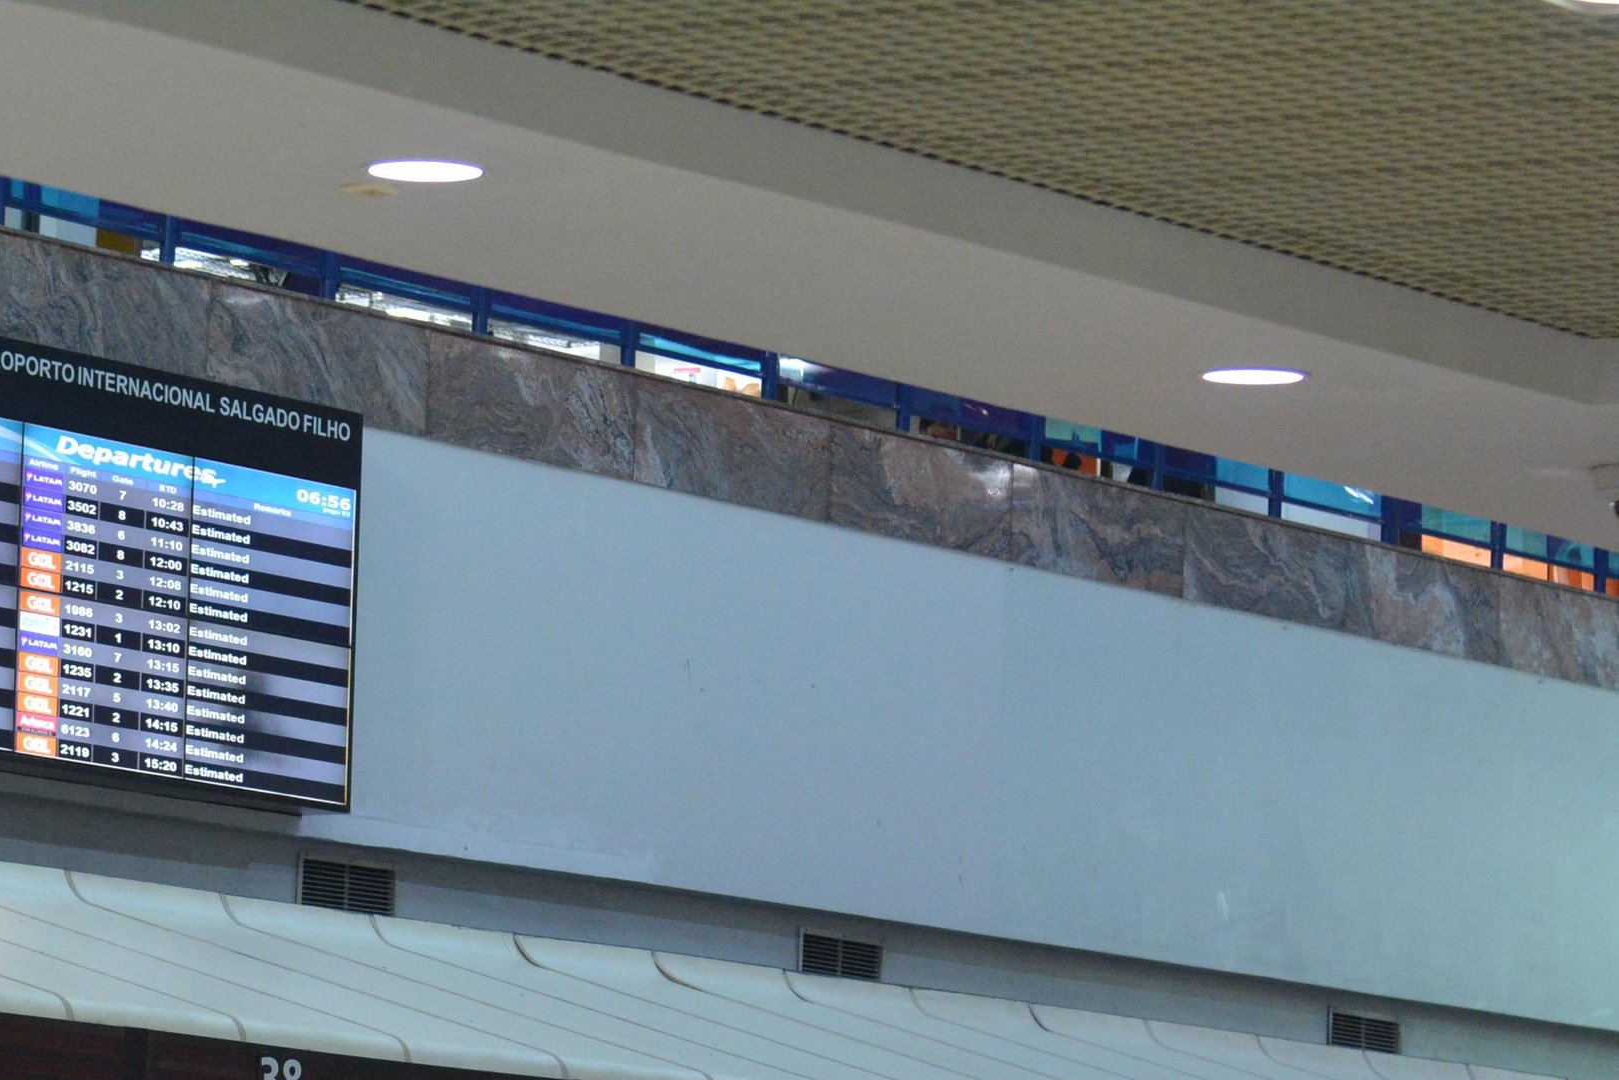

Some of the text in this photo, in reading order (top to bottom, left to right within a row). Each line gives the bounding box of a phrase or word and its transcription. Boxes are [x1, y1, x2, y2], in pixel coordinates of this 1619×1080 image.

[77, 365, 215, 413] INTERNACIONAL
[219, 396, 300, 430] SALGADO
[302, 413, 351, 441] FILHO
[53, 435, 218, 488] Departures
[68, 480, 97, 495] 3070
[296, 489, 351, 511] 06:56
[66, 519, 96, 534] 3836
[191, 523, 250, 545] Estimated
[65, 559, 94, 574] 2115
[64, 603, 93, 618] 1986
[188, 602, 248, 623] Estimated
[62, 643, 92, 658] 3160
[61, 683, 91, 698] 2117
[60, 723, 90, 738] 6123
[185, 724, 244, 744] Estimated
